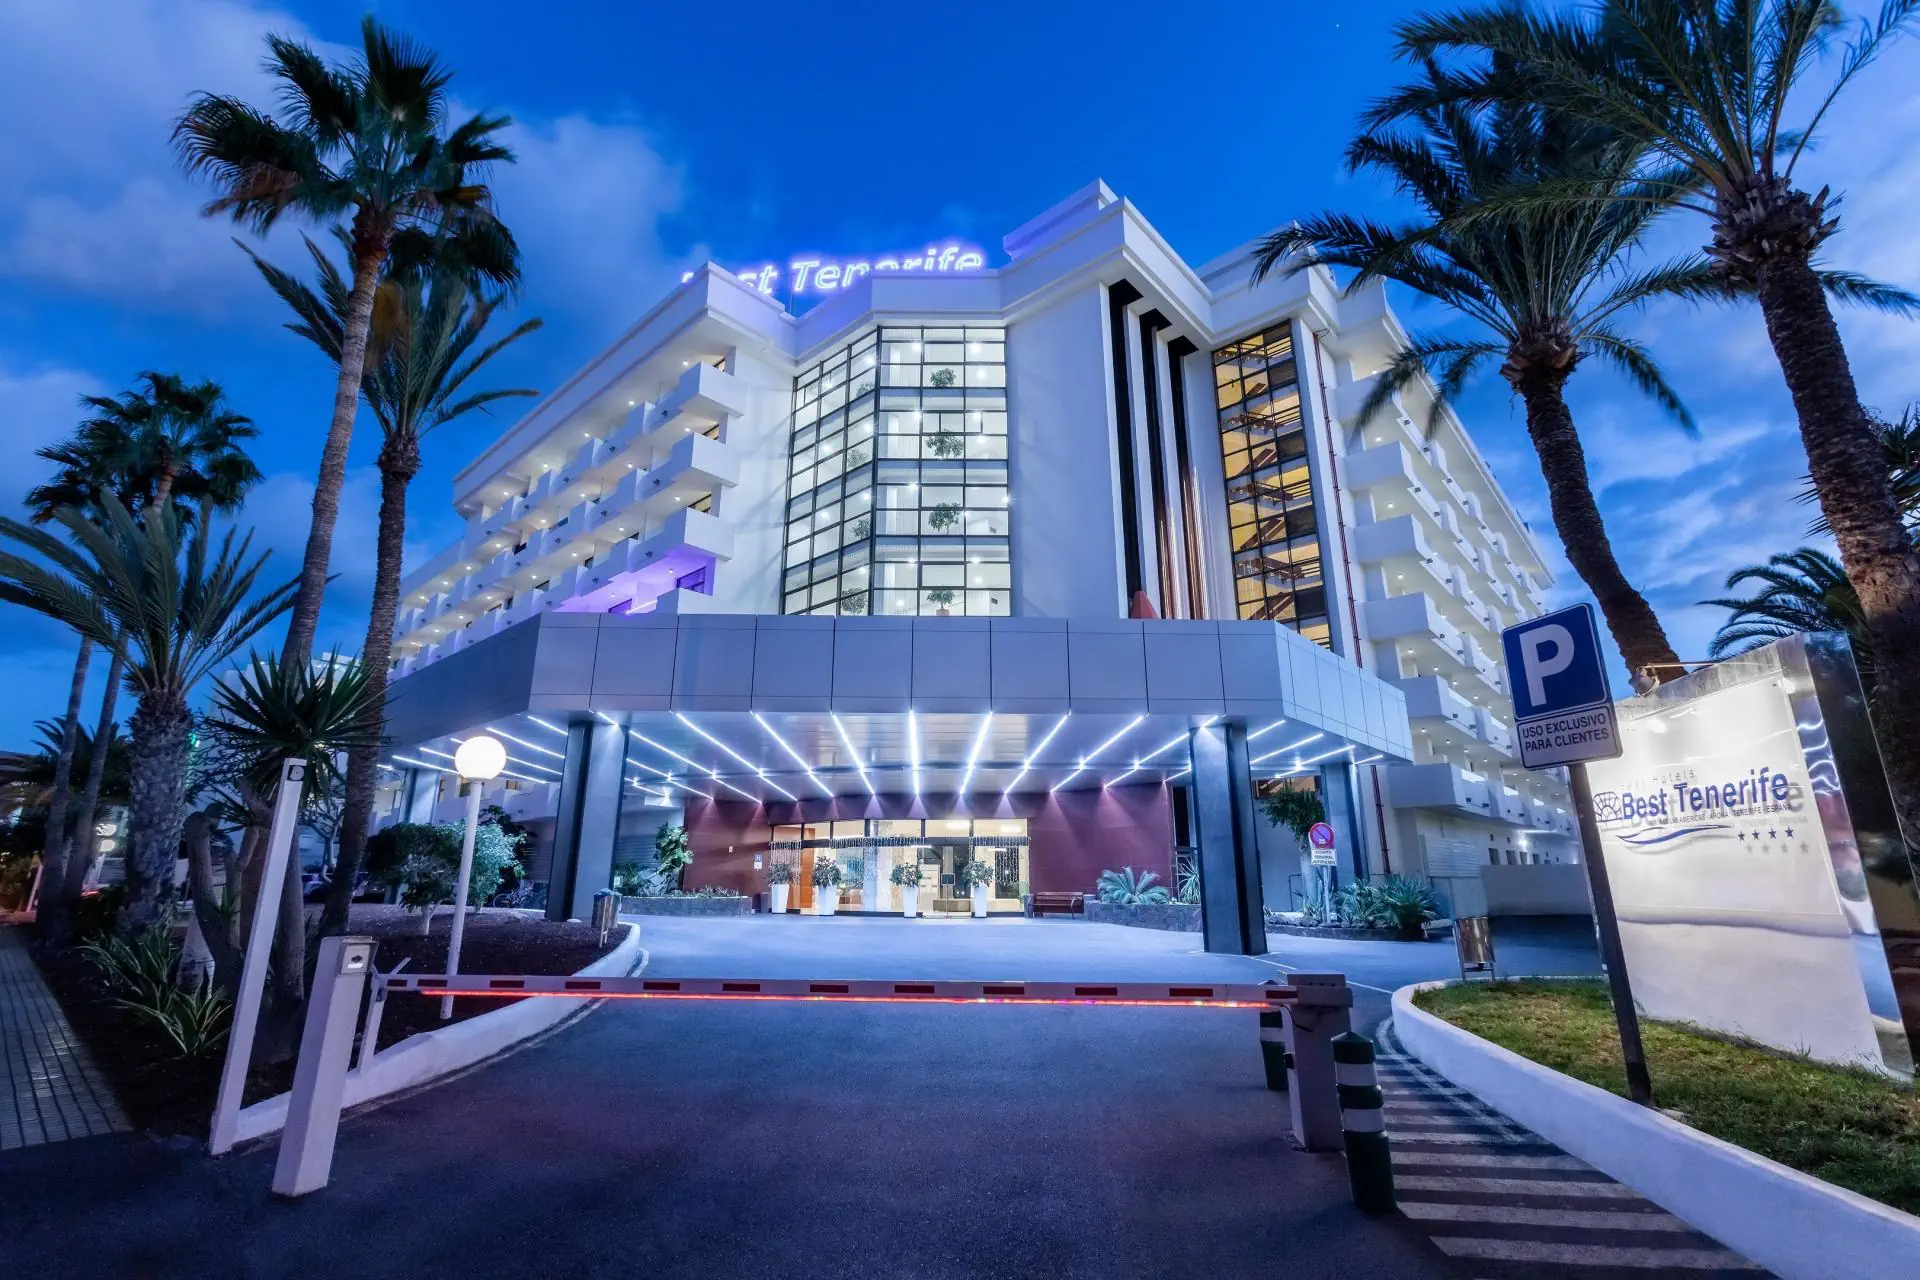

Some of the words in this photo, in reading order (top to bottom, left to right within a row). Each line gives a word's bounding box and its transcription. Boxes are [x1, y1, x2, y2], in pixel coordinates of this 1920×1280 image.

[1519, 624, 1575, 707] P
[1522, 725, 1544, 739] USO
[1546, 713, 1607, 734] EXCLUSIVO
[1524, 737, 1552, 752] PARA
[1555, 727, 1609, 745] CLIENTES
[1622, 787, 1668, 820] Best
[1673, 767, 1789, 813] Tenerife
